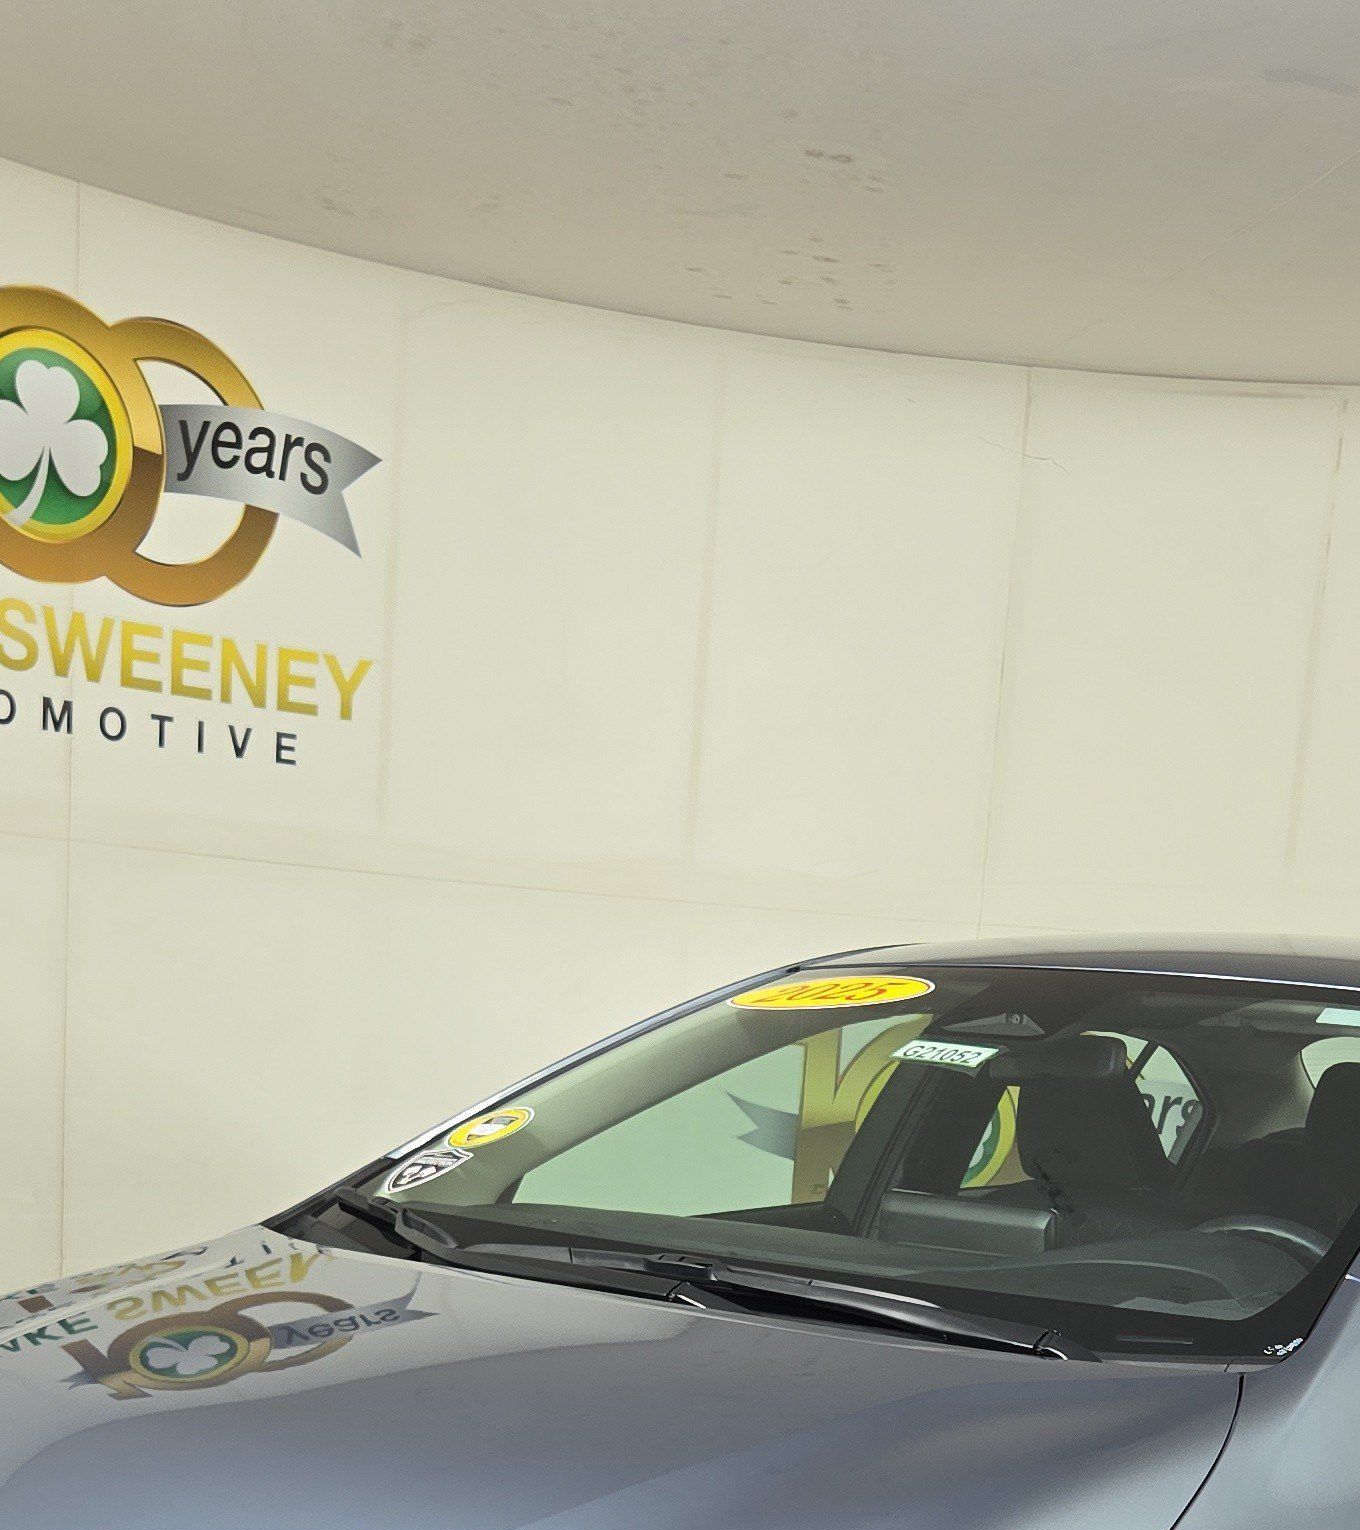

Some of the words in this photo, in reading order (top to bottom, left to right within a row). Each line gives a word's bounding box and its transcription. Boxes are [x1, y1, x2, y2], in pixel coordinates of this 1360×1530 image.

[176, 418, 332, 496] years
[750, 981, 909, 1003] 2025
[901, 1044, 981, 1065] G21052
